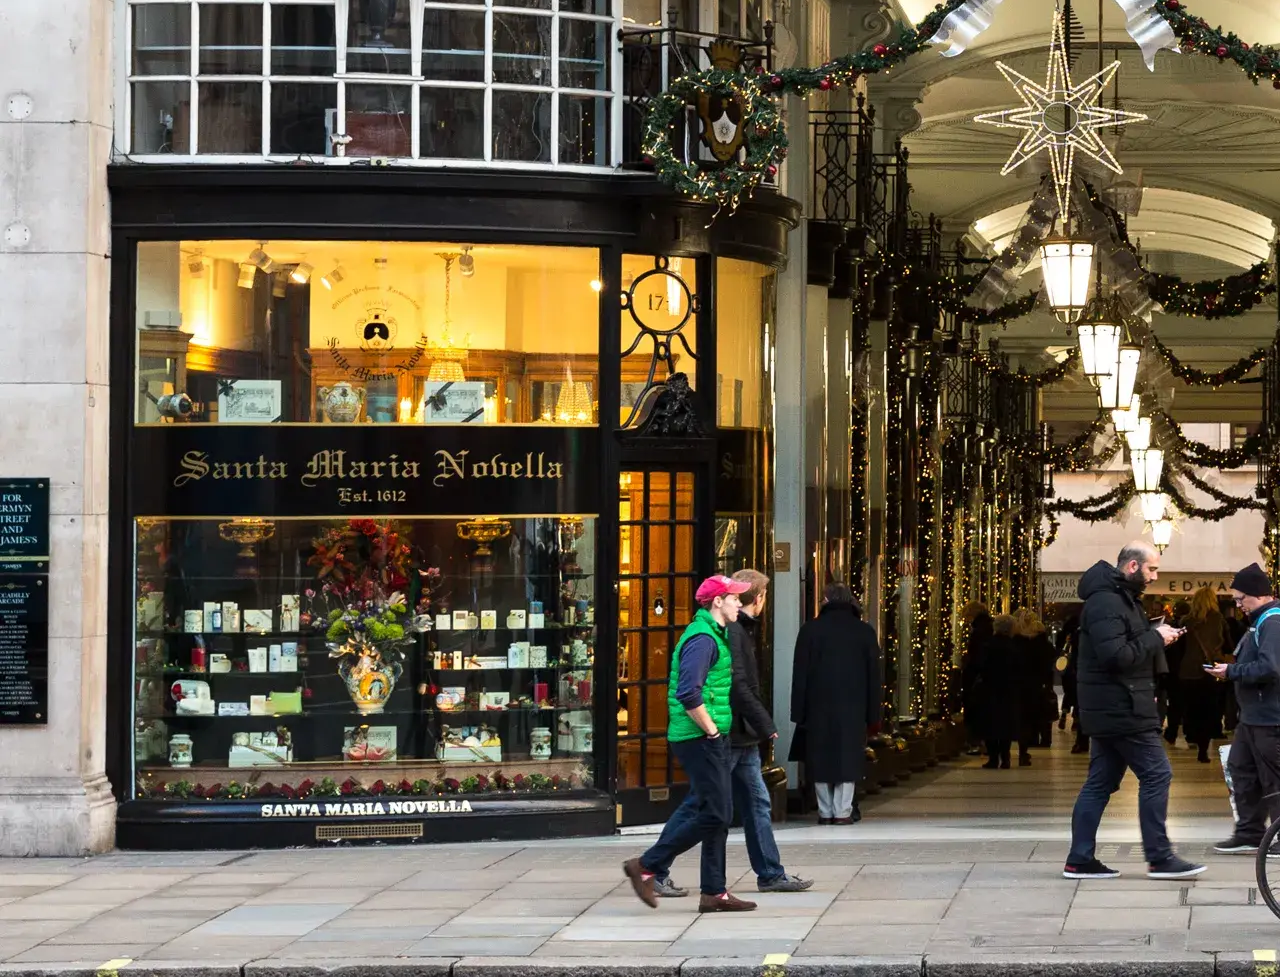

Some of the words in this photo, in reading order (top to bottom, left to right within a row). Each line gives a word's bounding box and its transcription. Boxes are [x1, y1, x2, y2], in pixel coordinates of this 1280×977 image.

[324, 336, 350, 372] Santa
[350, 367, 396, 382] Maria
[395, 333, 428, 376] Novella
[173, 450, 288, 487] Santa
[300, 449, 421, 487] Maria
[433, 449, 564, 487] Novella
[2, 494, 22, 502] FOR
[337, 487, 373, 506] Est.
[377, 489, 406, 503] 1612
[1, 525, 24, 534] AND
[261, 803, 321, 818] SANTA
[324, 801, 386, 817] MARIA
[388, 799, 473, 815] NOVELLA
